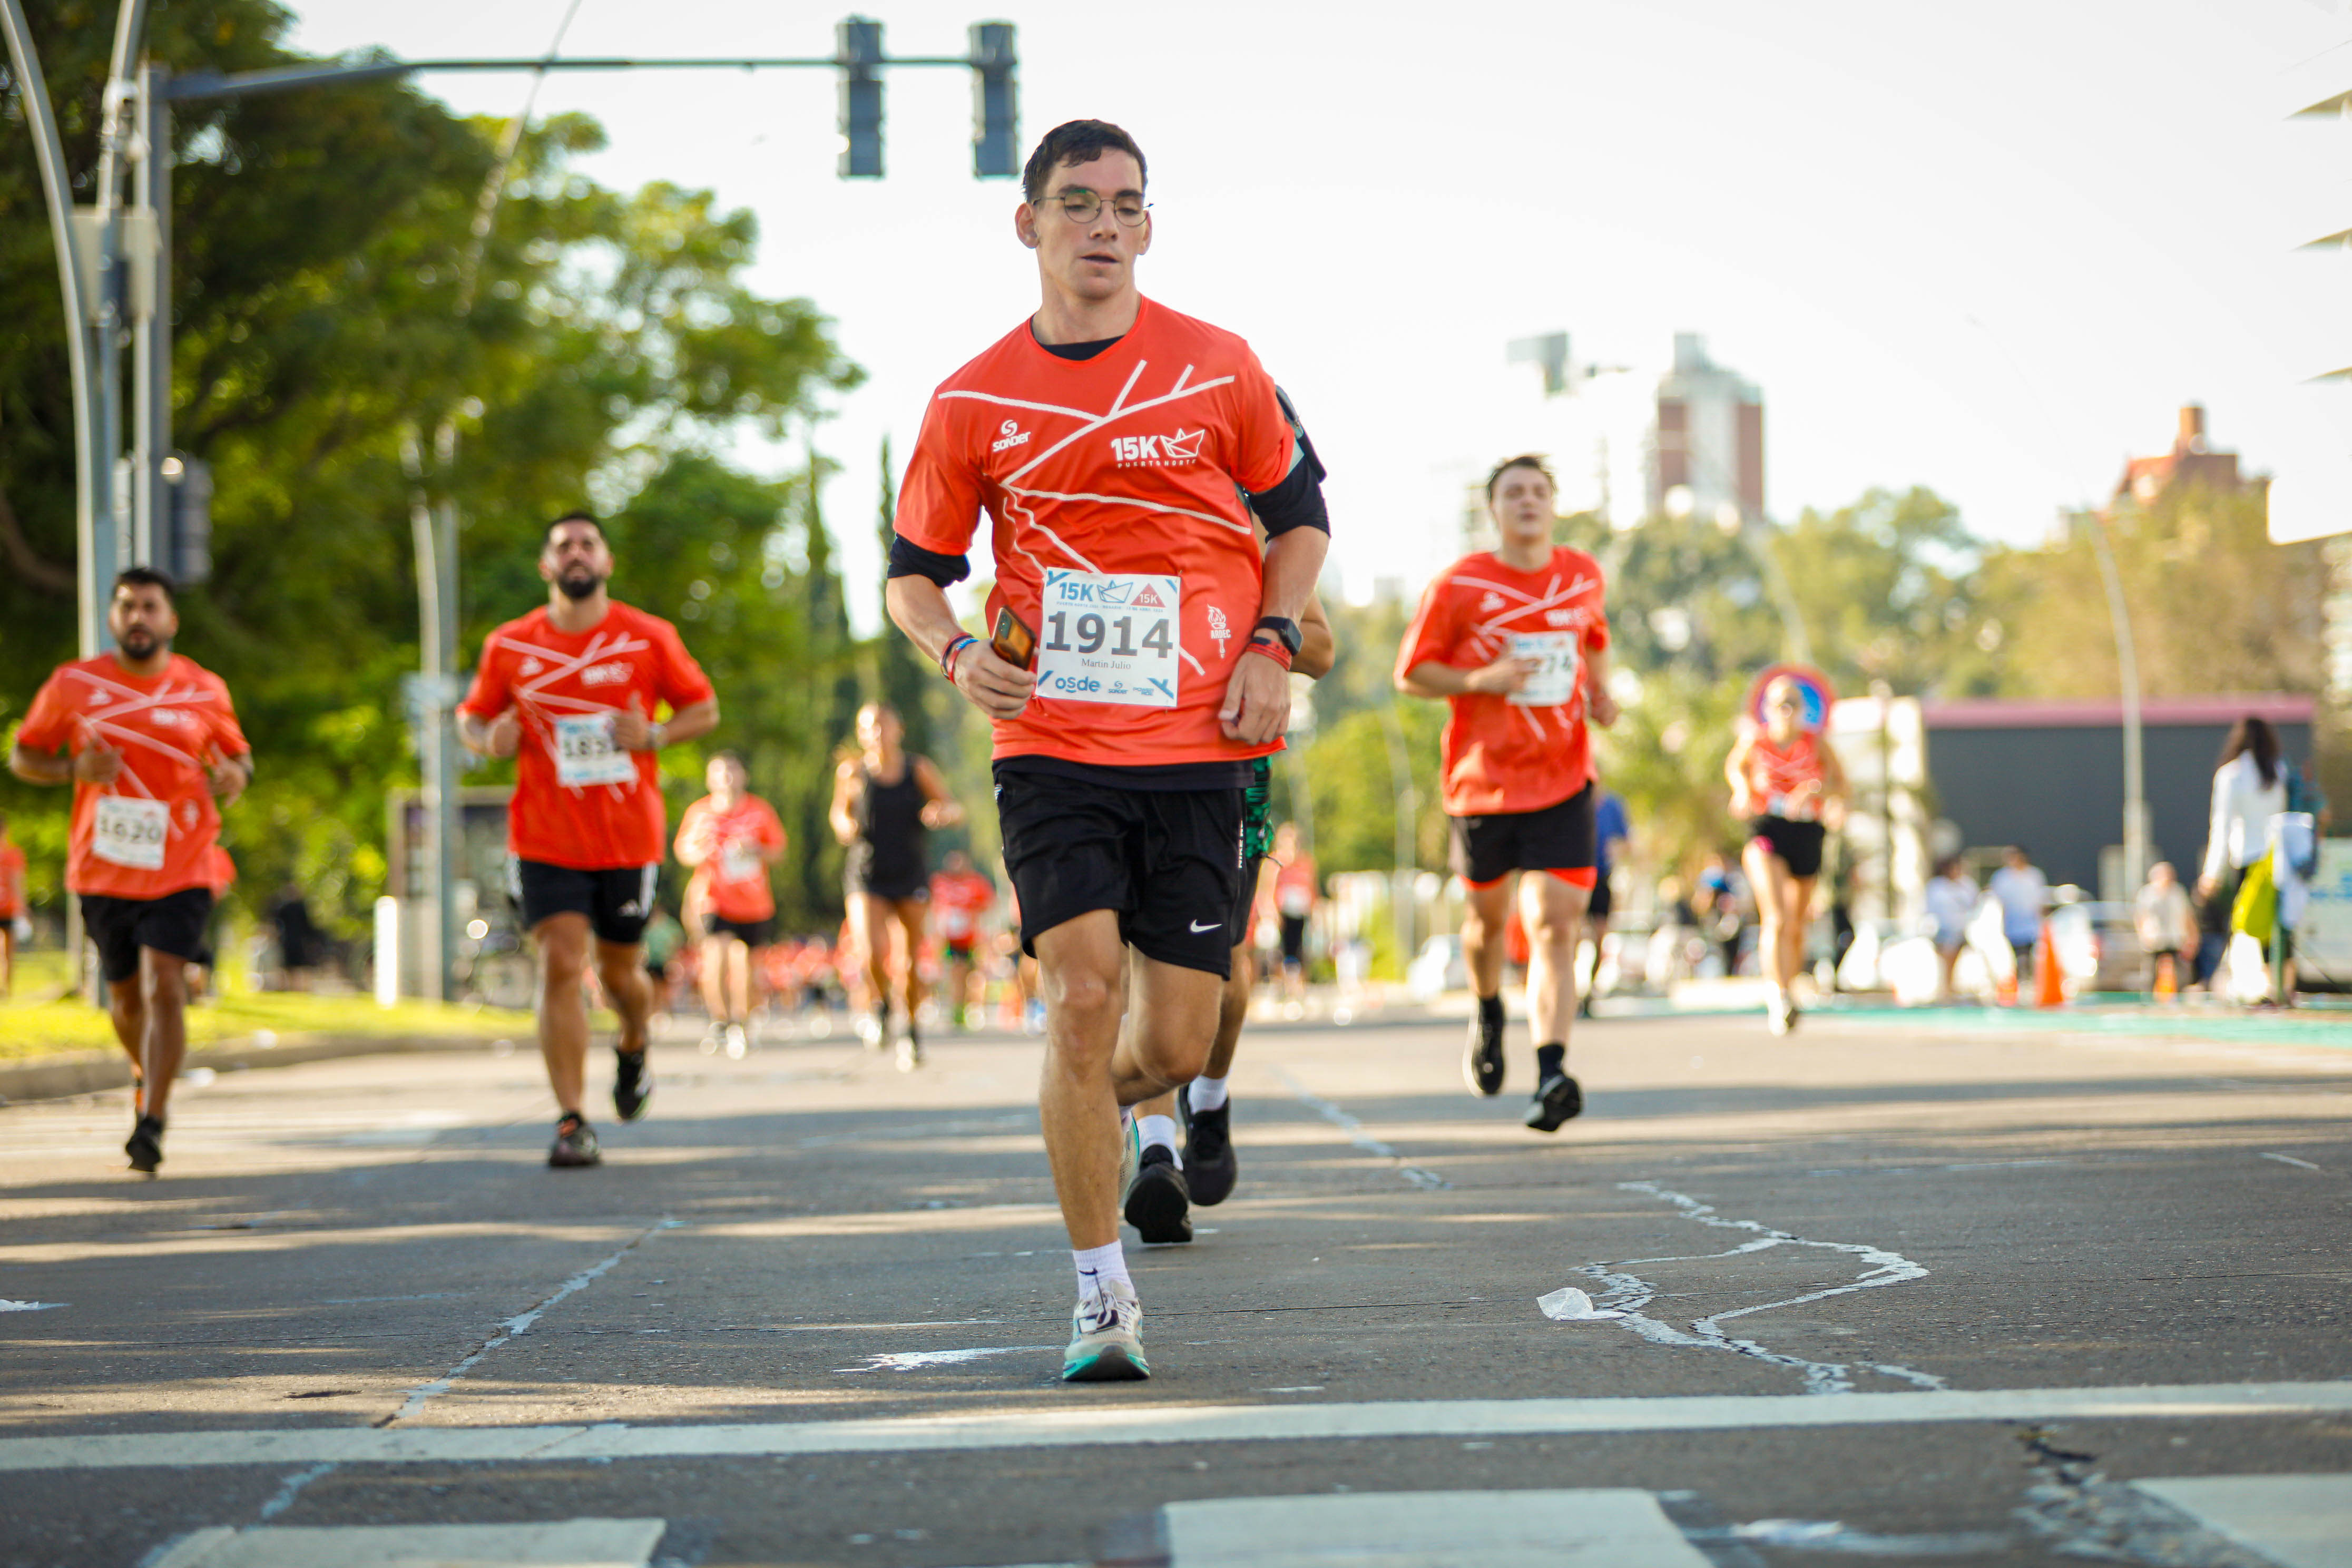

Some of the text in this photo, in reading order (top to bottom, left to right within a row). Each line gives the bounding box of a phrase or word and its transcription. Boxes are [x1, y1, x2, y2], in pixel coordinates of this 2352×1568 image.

[1111, 435, 1160, 461] 15K
[1118, 458, 1196, 469] PUERTO NORTE
[1059, 581, 1094, 602] 15K
[1139, 593, 1158, 604] 15K
[1046, 610, 1173, 659] 1914
[1081, 658, 1131, 670] Martin Julio
[1055, 676, 1101, 693] osde
